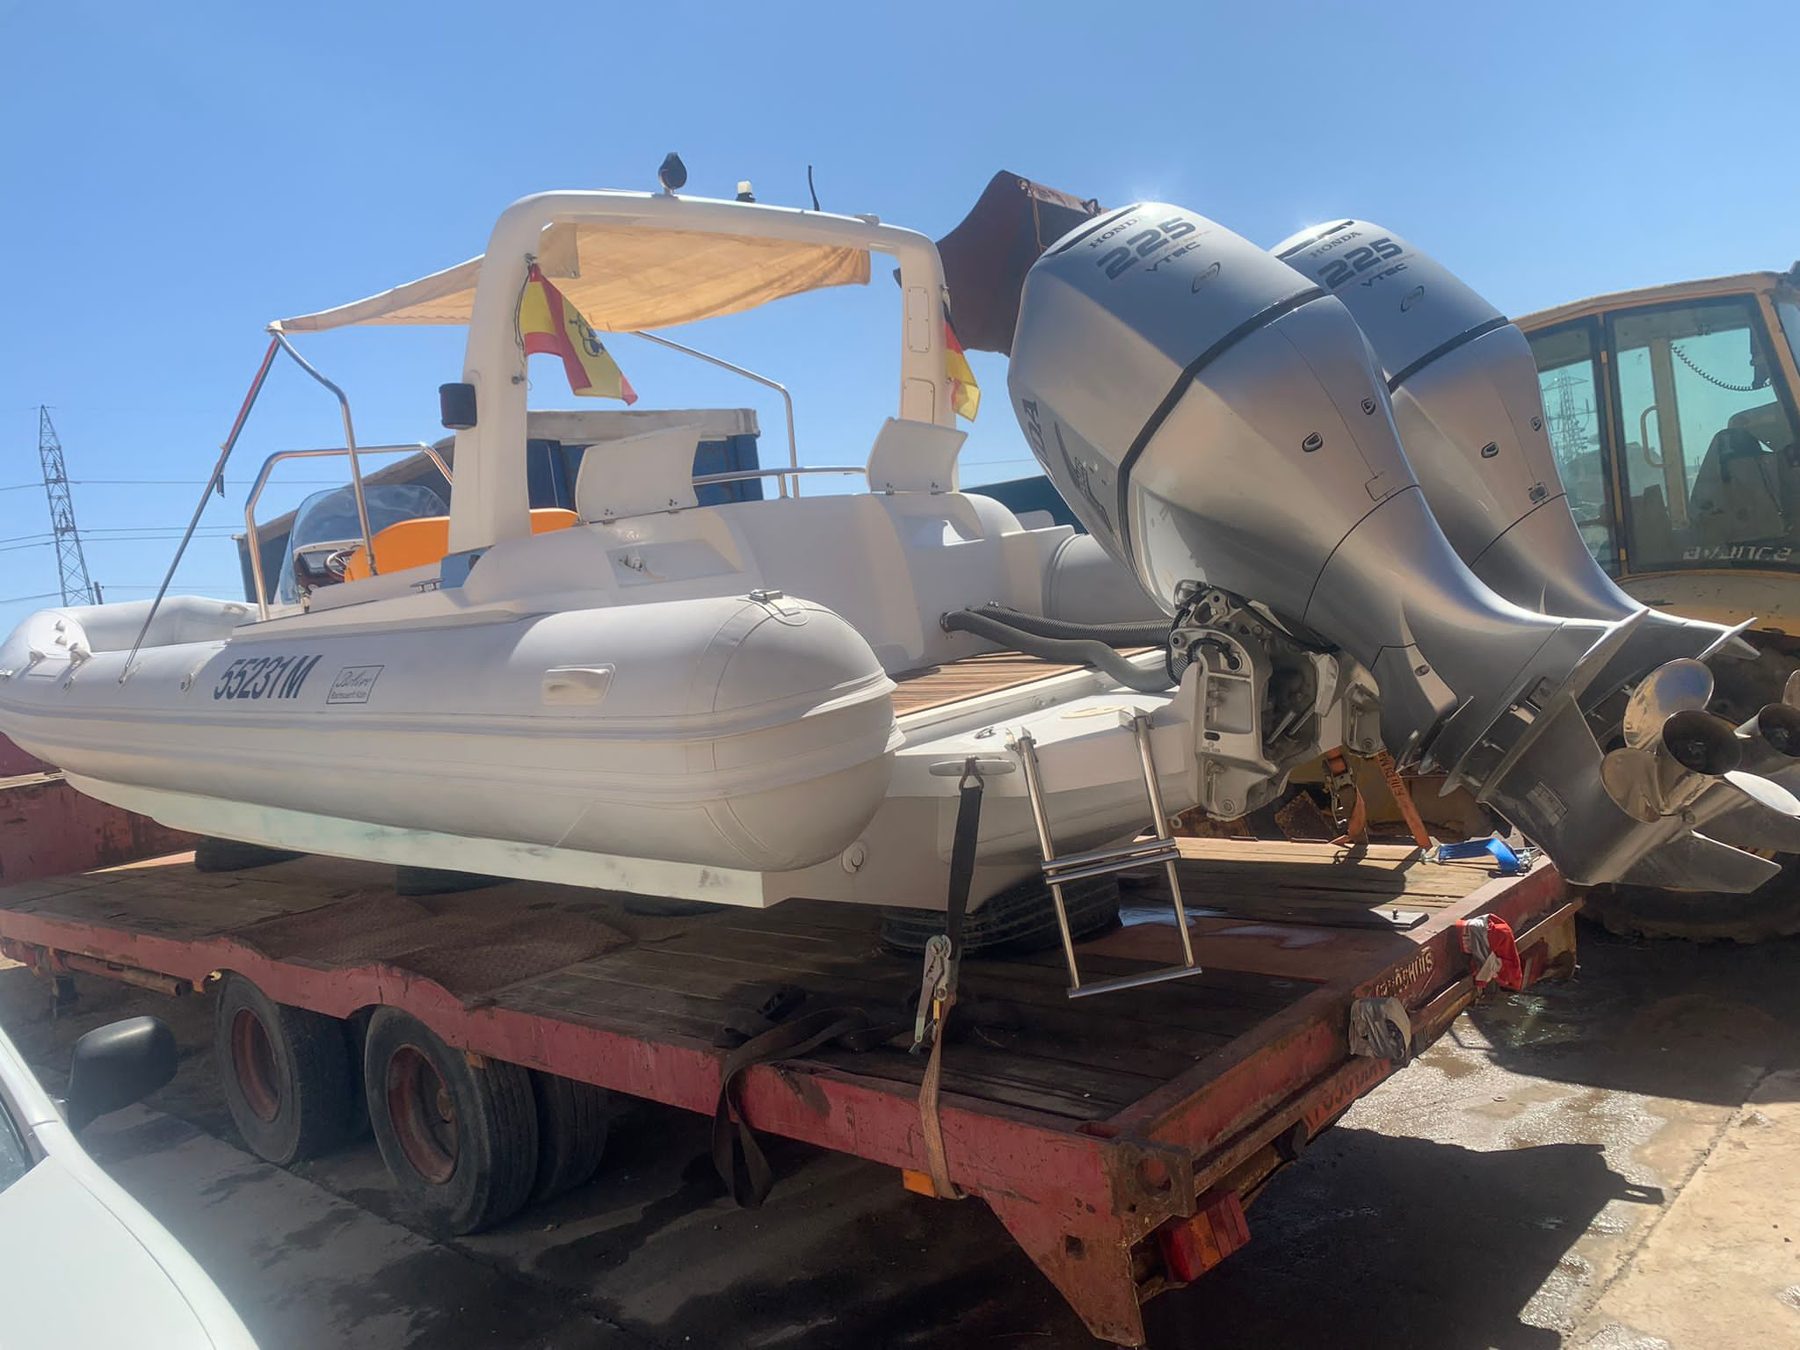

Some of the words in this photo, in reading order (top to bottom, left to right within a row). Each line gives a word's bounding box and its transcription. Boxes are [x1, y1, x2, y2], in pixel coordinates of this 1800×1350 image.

[1088, 216, 1144, 249] HOND
[1096, 217, 1196, 281] 225
[1309, 231, 1362, 258] HONDA
[1145, 240, 1201, 272] VTEC
[1317, 237, 1403, 290] 225
[1360, 262, 1409, 288] VTEC
[213, 654, 324, 700] 55231M
